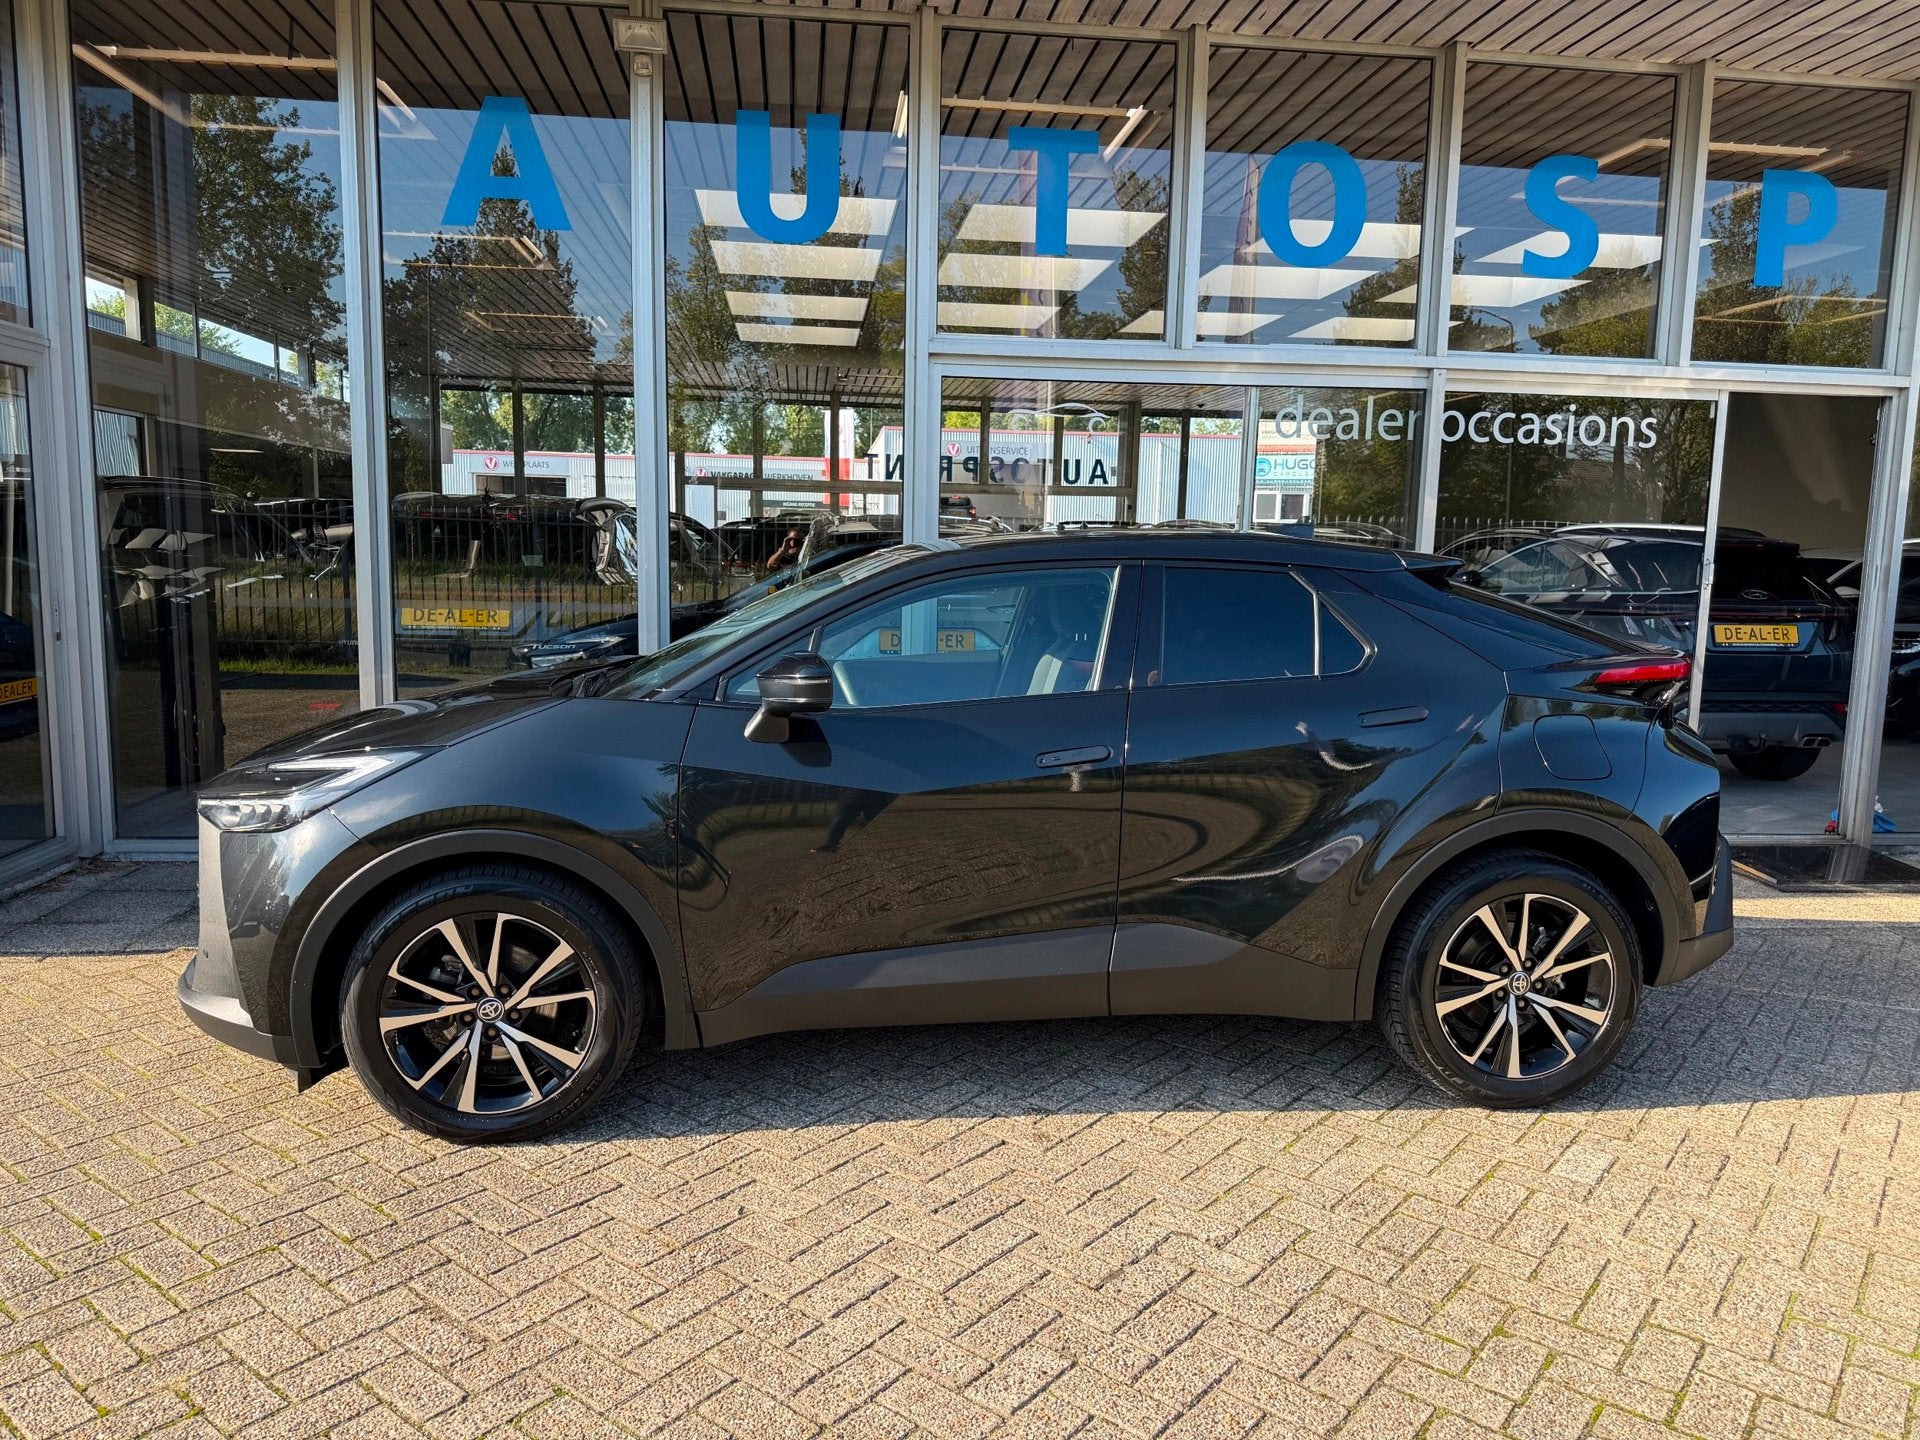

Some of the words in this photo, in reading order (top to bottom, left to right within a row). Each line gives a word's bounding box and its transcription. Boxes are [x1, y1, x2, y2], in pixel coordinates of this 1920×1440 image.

[1275, 393, 1423, 442] dealer
[1441, 403, 1658, 450] occasions
[966, 445, 1029, 456] UITNSERVICE
[502, 459, 551, 469] WEPLAATS
[710, 471, 756, 479] VAKGARAG
[412, 608, 499, 624] DE-AL-ER
[1723, 626, 1791, 642] DE-AL-ER
